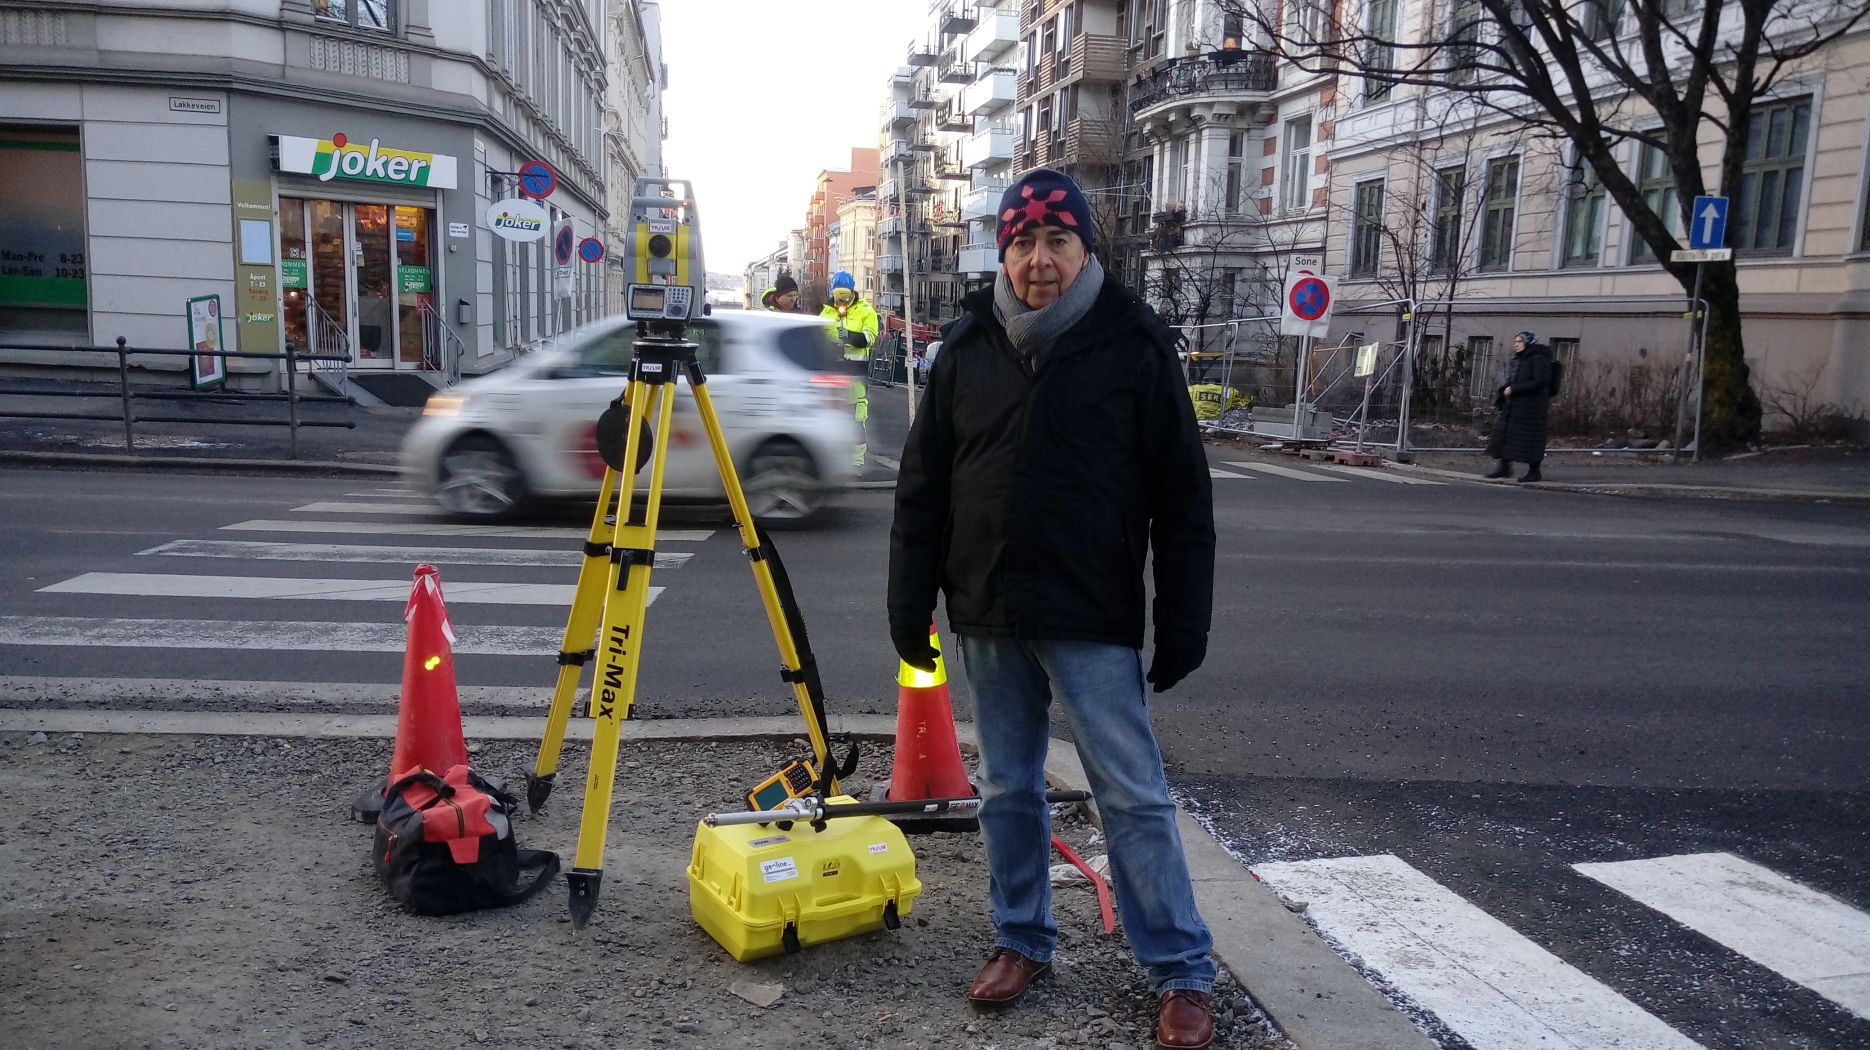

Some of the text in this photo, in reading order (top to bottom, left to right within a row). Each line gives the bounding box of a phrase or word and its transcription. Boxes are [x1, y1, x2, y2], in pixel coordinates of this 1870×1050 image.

[319, 132, 429, 182] joker
[495, 211, 541, 230] joker
[1295, 257, 1317, 266] Sone
[247, 312, 272, 323] joker
[599, 624, 630, 720] Tri-Max
